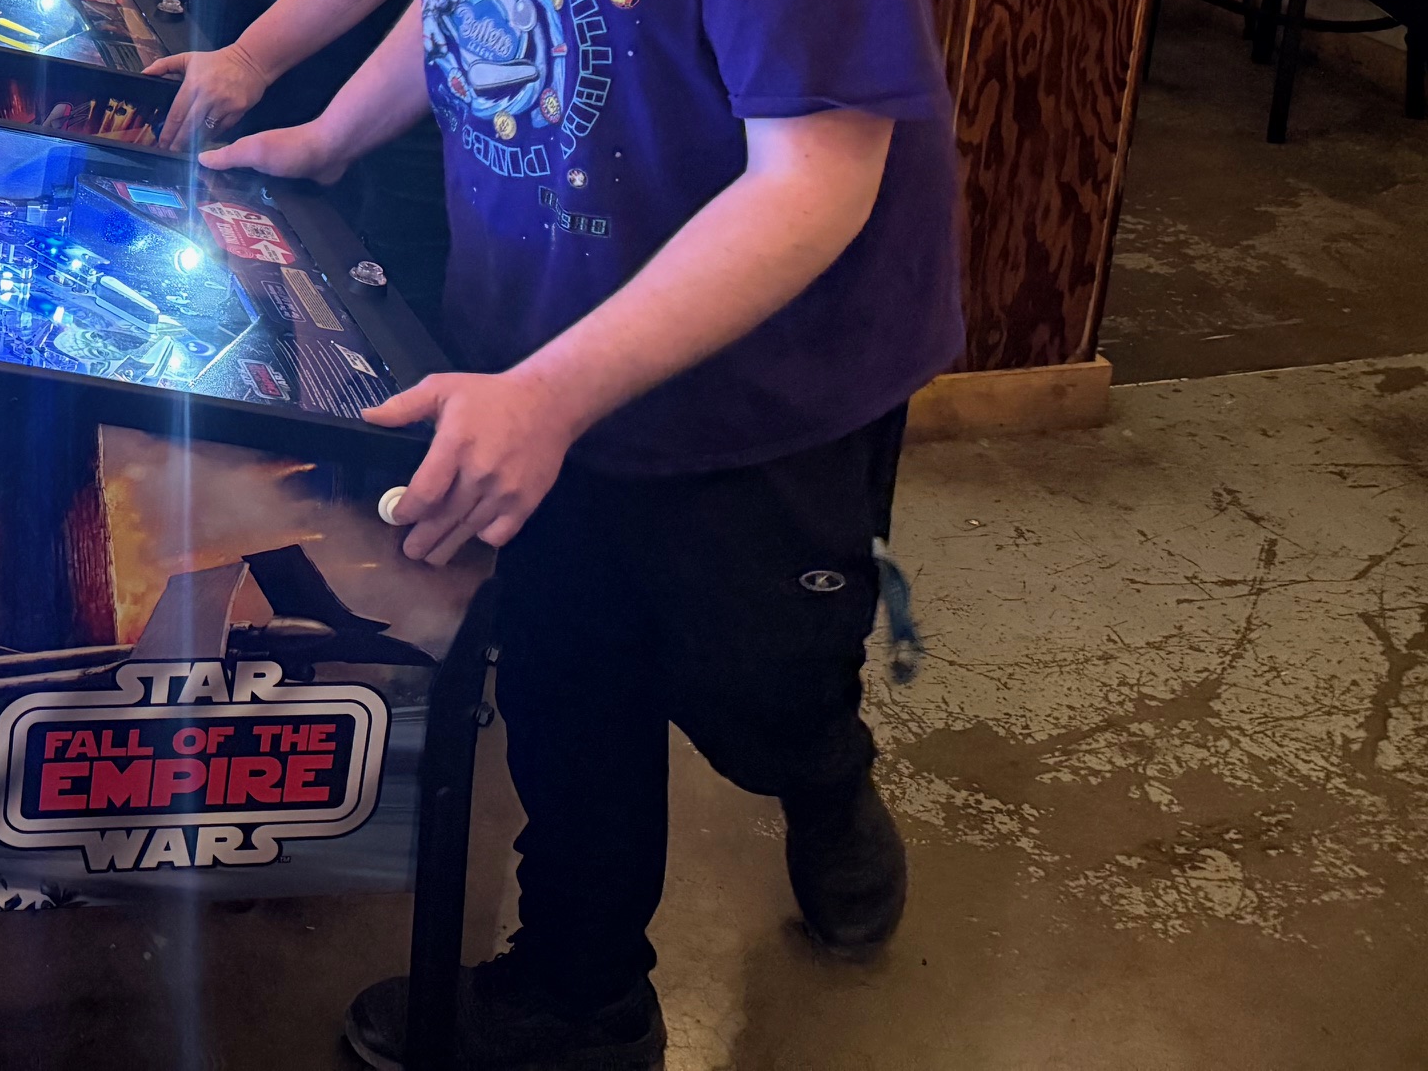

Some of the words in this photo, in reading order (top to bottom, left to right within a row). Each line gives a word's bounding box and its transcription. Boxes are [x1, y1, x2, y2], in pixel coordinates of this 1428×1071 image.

[442, 97, 551, 177] PINBA
[116, 660, 289, 705] STAR
[44, 729, 154, 759] FALL
[172, 726, 235, 755] OF
[252, 723, 337, 753] THE
[38, 754, 334, 811] EMPIRE
[82, 825, 279, 871] WARS
